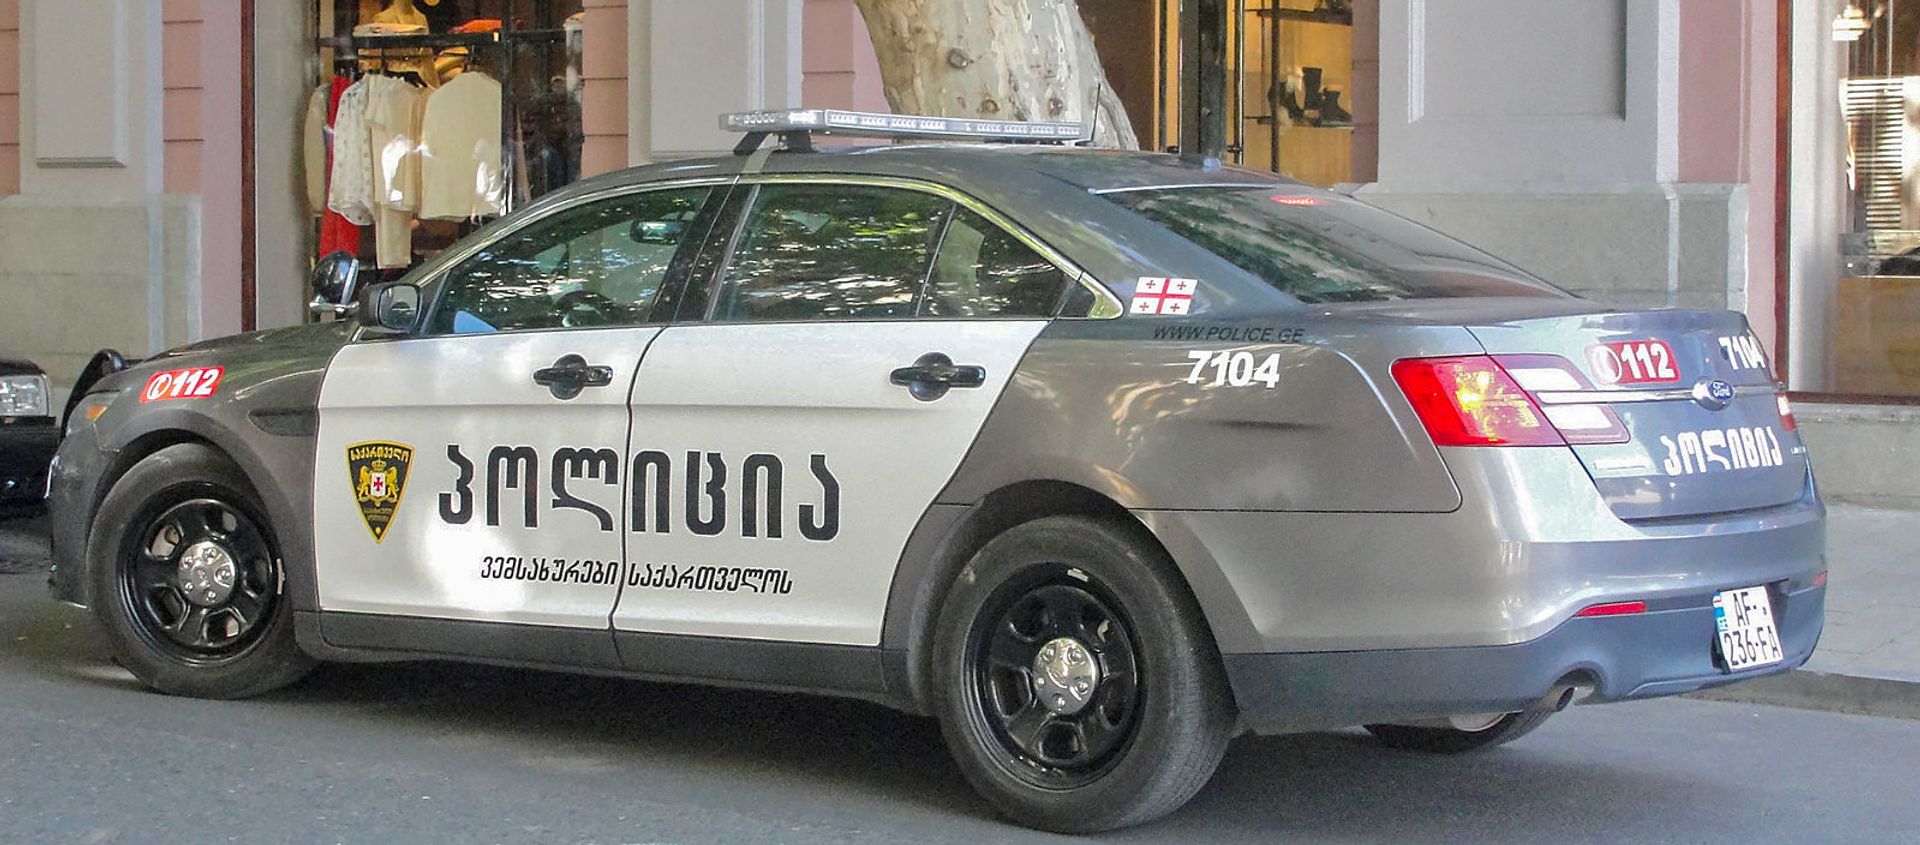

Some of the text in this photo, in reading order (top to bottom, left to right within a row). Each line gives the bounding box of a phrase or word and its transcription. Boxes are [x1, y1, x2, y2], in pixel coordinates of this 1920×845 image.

[1153, 326, 1305, 343] WWW.POLICE.GE
[1719, 336, 1766, 370] 7104
[1187, 350, 1281, 389] 7104
[1621, 343, 1676, 379] 112
[169, 368, 220, 397] 112
[1659, 426, 1783, 477] პოლიცია
[438, 444, 841, 541] პოლიცია
[481, 556, 793, 594] ვემსახურები საქართველოს
